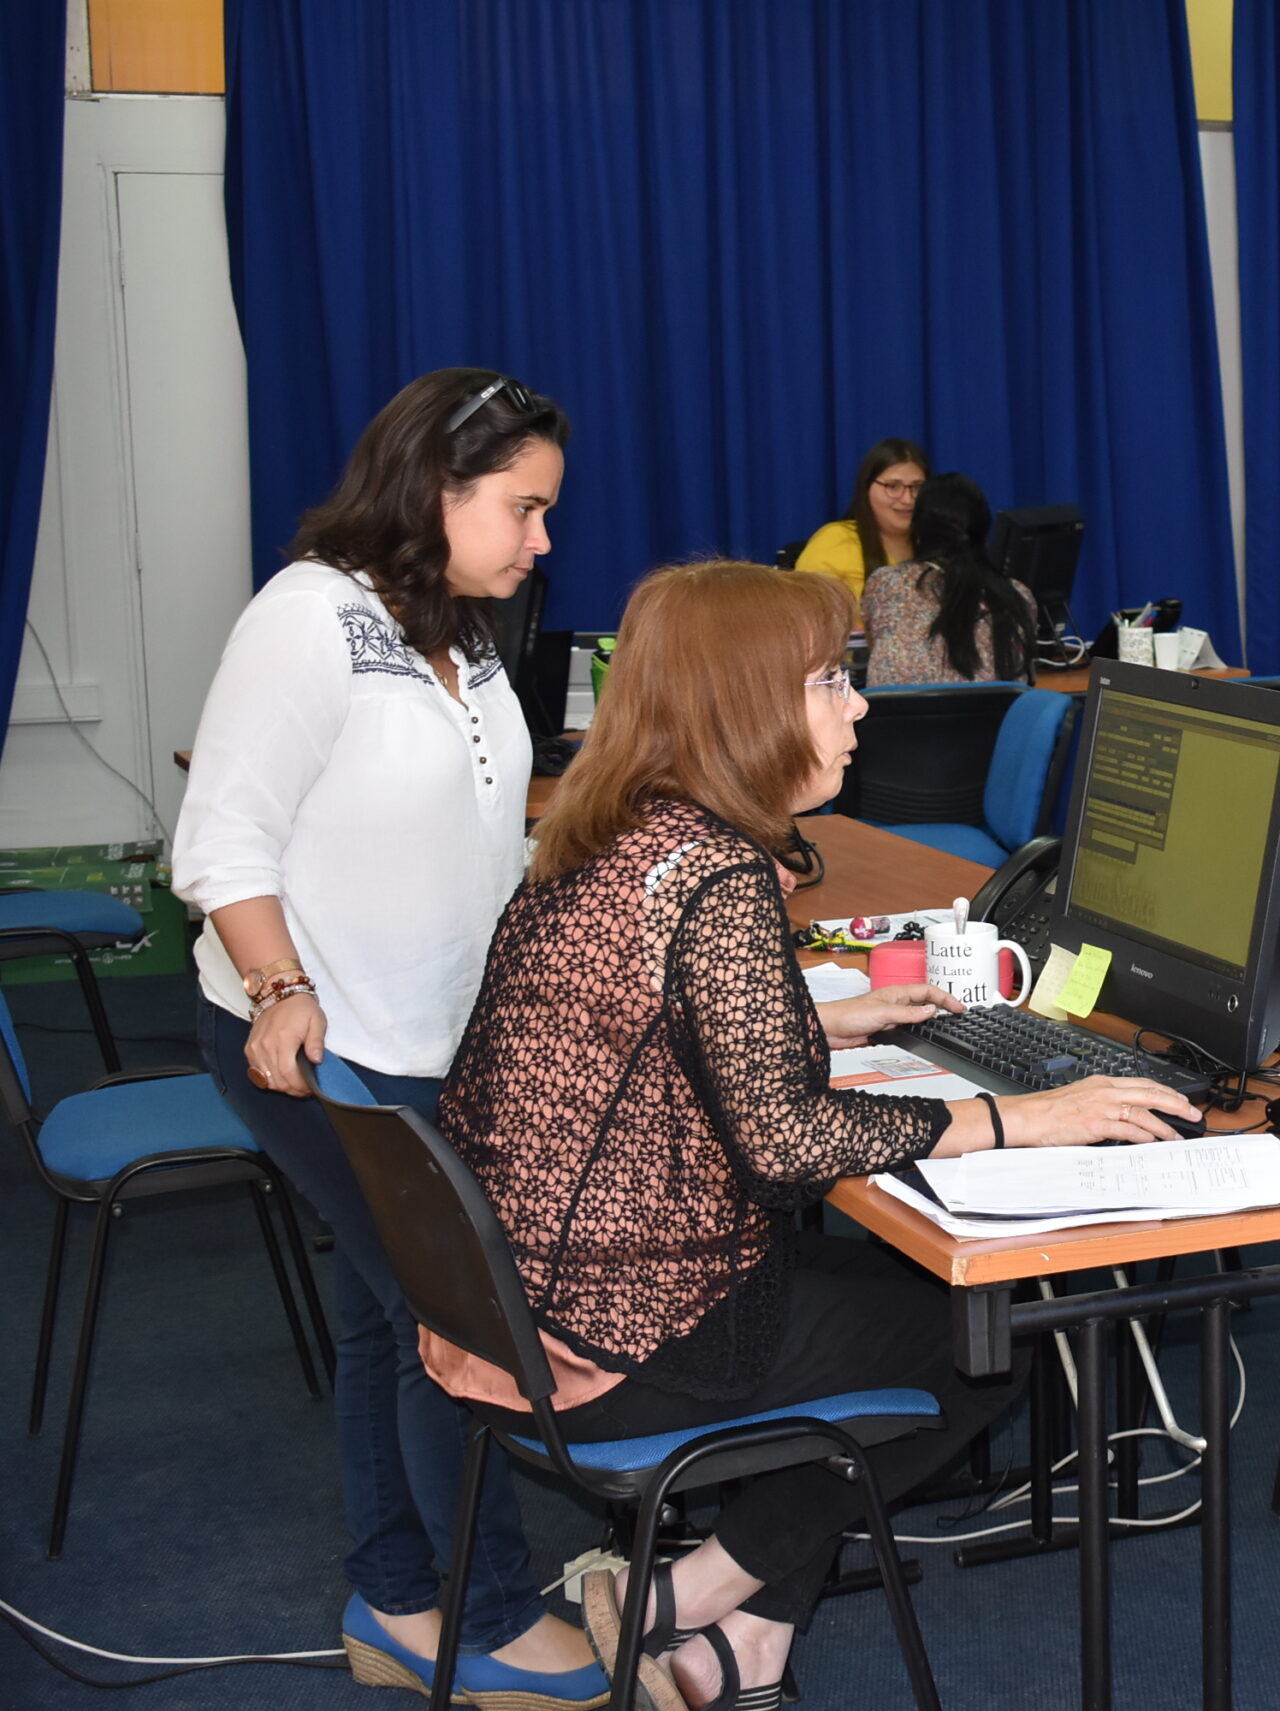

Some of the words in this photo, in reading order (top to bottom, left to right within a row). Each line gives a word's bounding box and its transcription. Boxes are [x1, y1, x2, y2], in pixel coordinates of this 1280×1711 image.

[930, 940, 973, 958] Latte
[943, 966, 973, 976] Latte
[1130, 963, 1154, 979] lenovo
